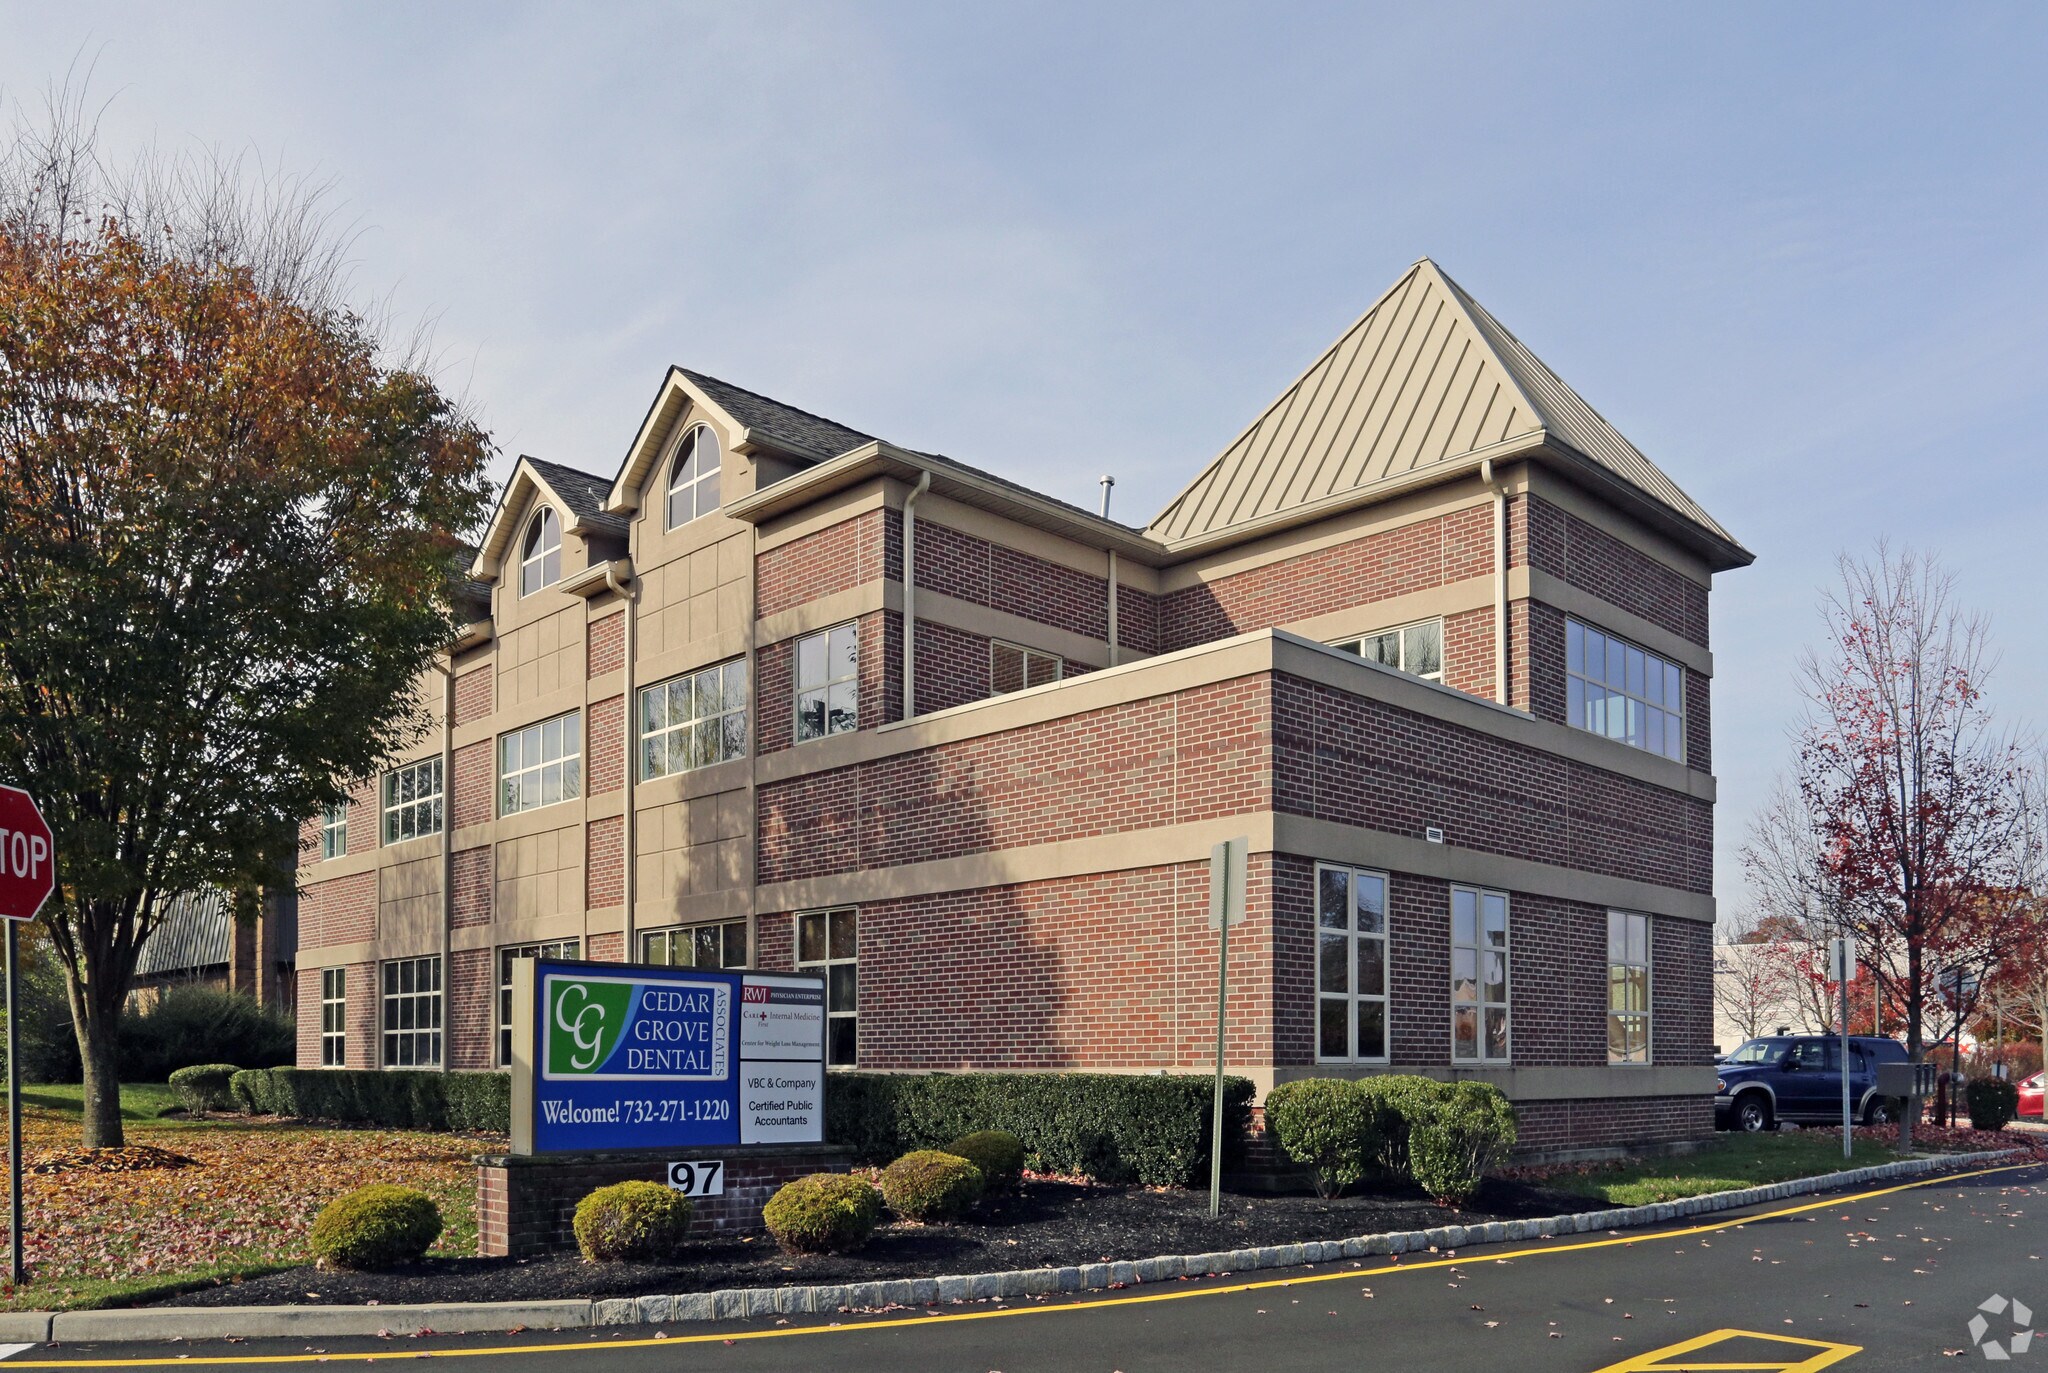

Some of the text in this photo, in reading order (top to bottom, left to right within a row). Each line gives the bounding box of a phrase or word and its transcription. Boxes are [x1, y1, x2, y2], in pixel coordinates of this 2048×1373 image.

[0, 828, 48, 880] TOP
[1713, 959, 1728, 969] re
[642, 990, 710, 1013] CEDAR
[743, 987, 766, 1004] RWJ
[769, 1011, 793, 1020] Internal
[793, 1012, 820, 1021] Medicine
[635, 1020, 709, 1042] GROVE
[715, 988, 727, 1077] ASSOCIATES
[764, 1040, 781, 1048] Weight
[627, 1048, 710, 1070] DENTAL
[747, 1077, 816, 1091] VBC & Company
[541, 1099, 730, 1124] Welcome! 732-271-1220
[748, 1099, 813, 1111] Certified Public
[754, 1116, 808, 1126] Accountants
[670, 1162, 721, 1195] 97
